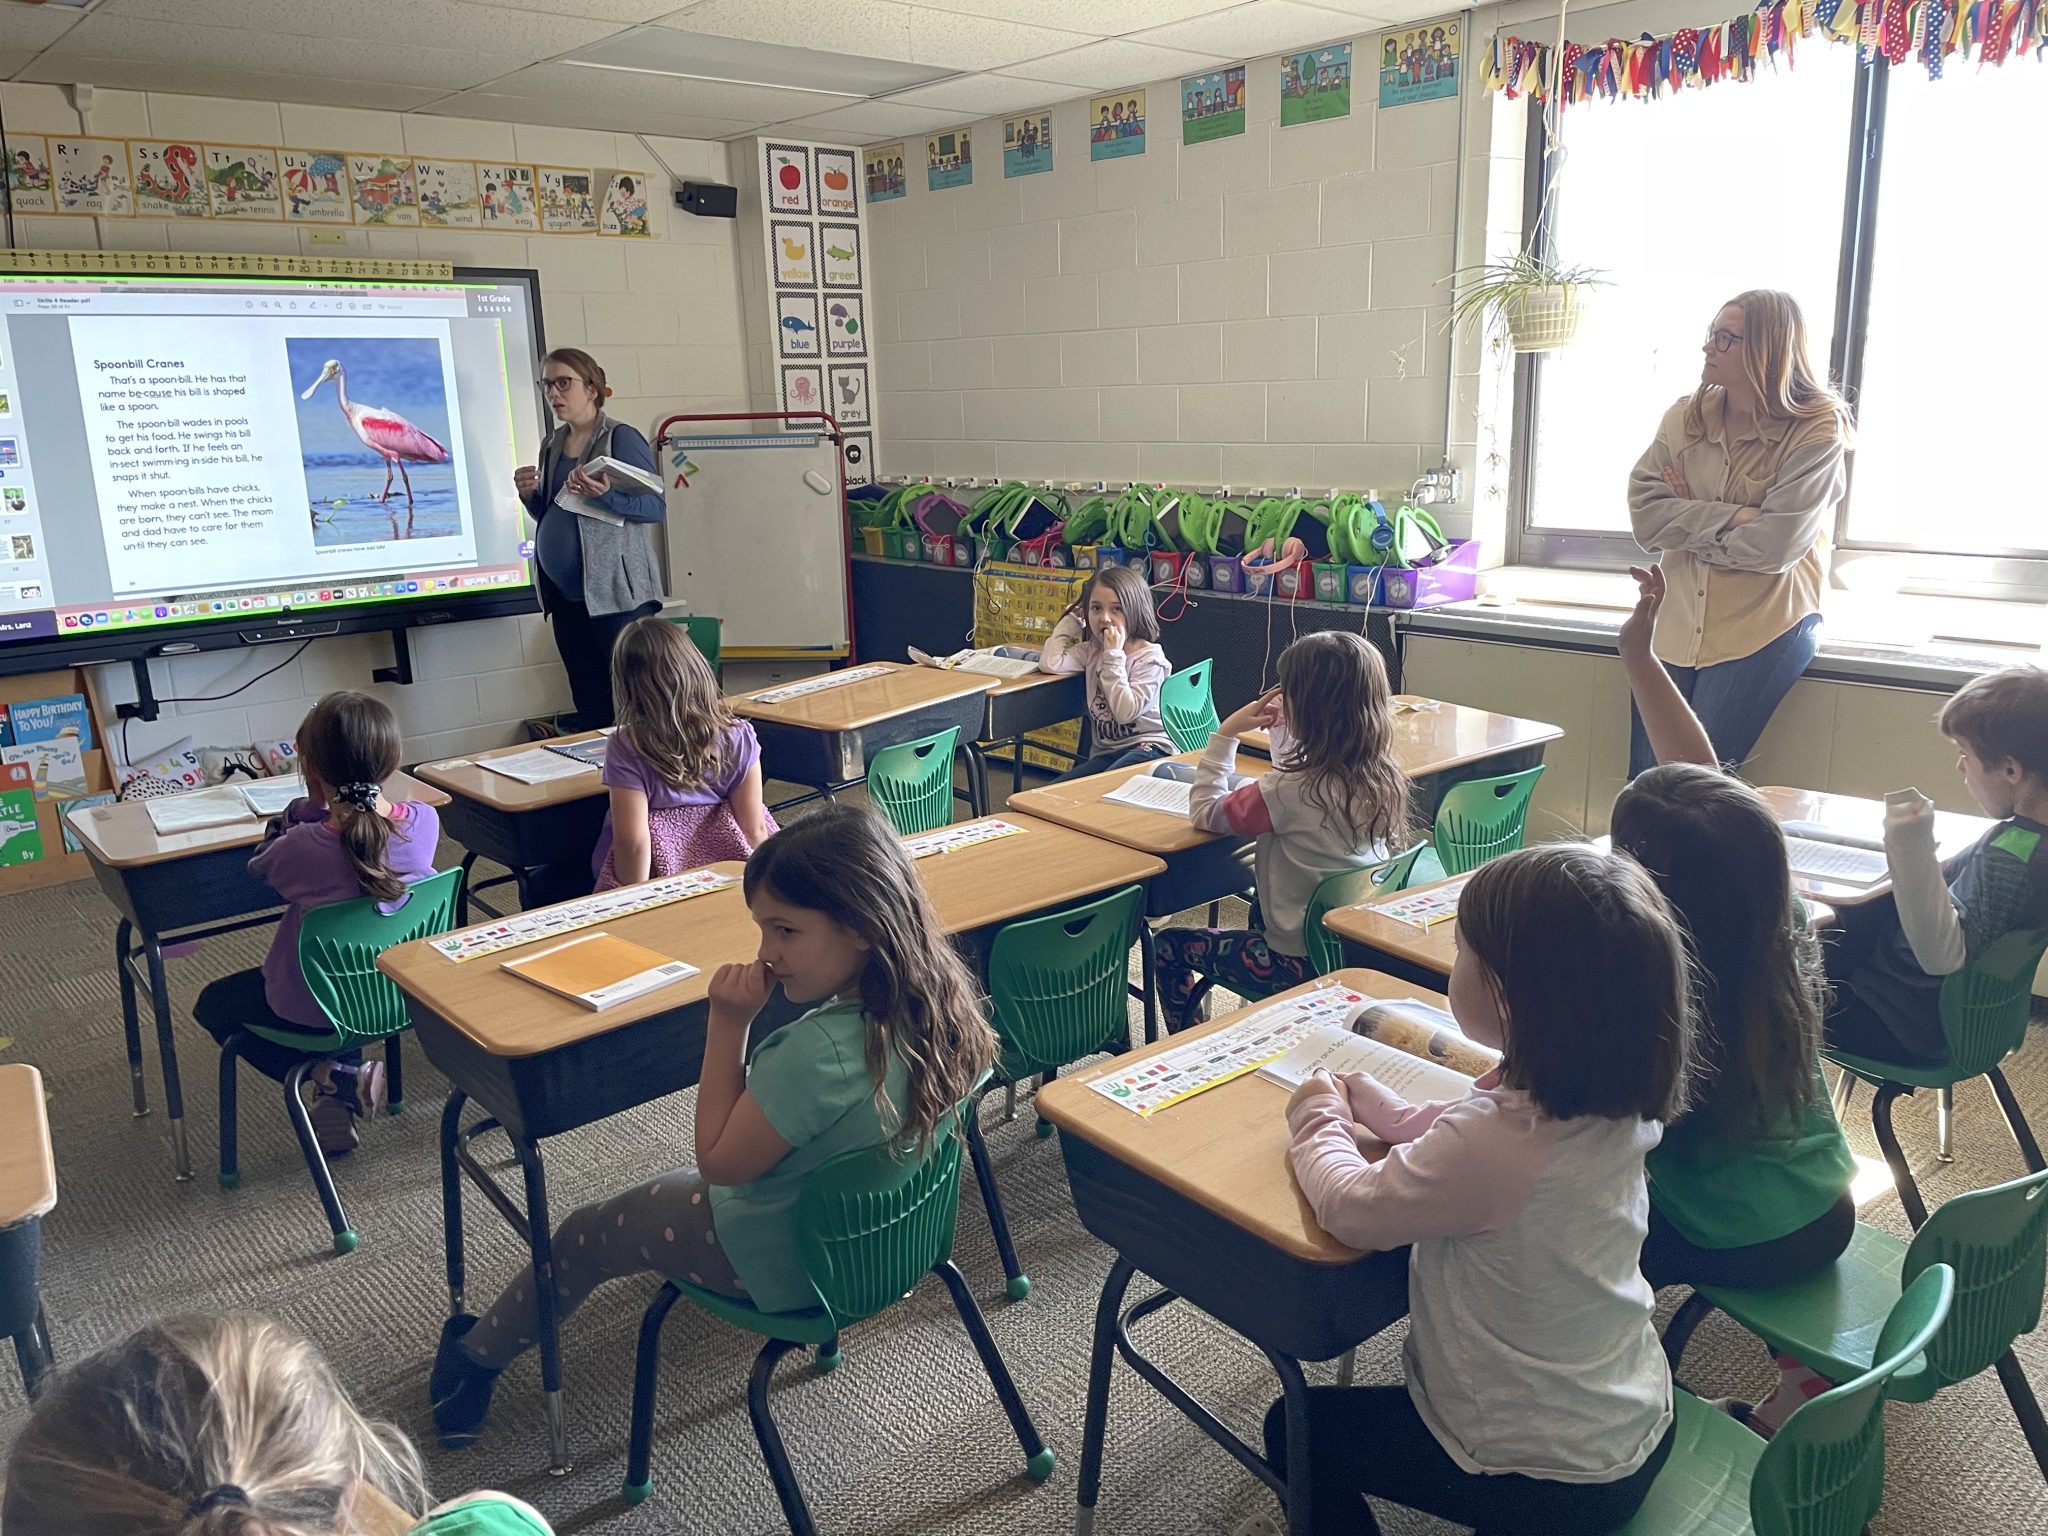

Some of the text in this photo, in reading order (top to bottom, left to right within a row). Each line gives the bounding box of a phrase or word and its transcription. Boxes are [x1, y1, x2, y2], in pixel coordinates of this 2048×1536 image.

[57, 144, 67, 155] R
[140, 148, 147, 158] S
[212, 152, 230, 163] T t
[284, 157, 294, 166] U
[355, 162, 363, 172] V
[418, 165, 430, 175] W
[483, 169, 491, 179] X
[544, 174, 561, 187] Y y
[16, 197, 45, 208] quack
[782, 195, 799, 205] red
[822, 198, 854, 210] orange
[309, 208, 345, 217] umbrella
[455, 215, 473, 223] wind
[548, 221, 571, 231] yogurt
[782, 268, 810, 280] yellow
[829, 271, 855, 282] green
[790, 339, 810, 349] blue
[832, 339, 860, 350] purple
[94, 359, 185, 371] Spoonbill Cranes
[110, 375, 137, 384] That's
[195, 375, 208, 383] He
[210, 374, 227, 383] has
[229, 374, 247, 382] that
[174, 388, 187, 396] his
[189, 387, 202, 396] bill
[204, 388, 210, 396] is
[213, 387, 246, 397] shaped
[100, 403, 116, 411] like
[128, 403, 160, 412] spoon.
[841, 409, 861, 420] grey
[116, 420, 135, 429] The
[182, 418, 212, 427] wades
[225, 417, 249, 427] pools
[119, 434, 134, 444] get
[136, 433, 150, 441] his
[152, 432, 176, 441] food.
[178, 431, 191, 440] He
[194, 432, 223, 441] swings
[239, 429, 251, 438] bill
[108, 447, 132, 456] back
[134, 445, 153, 454] and
[155, 445, 181, 453] forth.
[183, 444, 190, 452] If
[193, 444, 205, 452] he
[208, 442, 229, 451] feels
[235, 454, 250, 463] bill,
[112, 474, 139, 483] snaps
[150, 471, 171, 480] shut.
[128, 490, 157, 498] When
[232, 484, 261, 492] chicks,
[117, 504, 138, 514] they
[141, 502, 166, 510] make
[178, 500, 198, 508] nest.
[200, 498, 228, 506] When
[247, 495, 273, 504] chicks
[166, 514, 186, 523] they
[189, 511, 210, 520] can't
[232, 509, 249, 517] The
[122, 528, 140, 538] and
[143, 527, 162, 536] dad
[225, 522, 238, 530] for
[147, 541, 168, 550] they
[14, 701, 82, 720] HAPPY BIRTHDAY
[31, 716, 53, 730] YOU!
[22, 851, 34, 859] By
[1295, 1047, 1335, 1075] Cranes and
